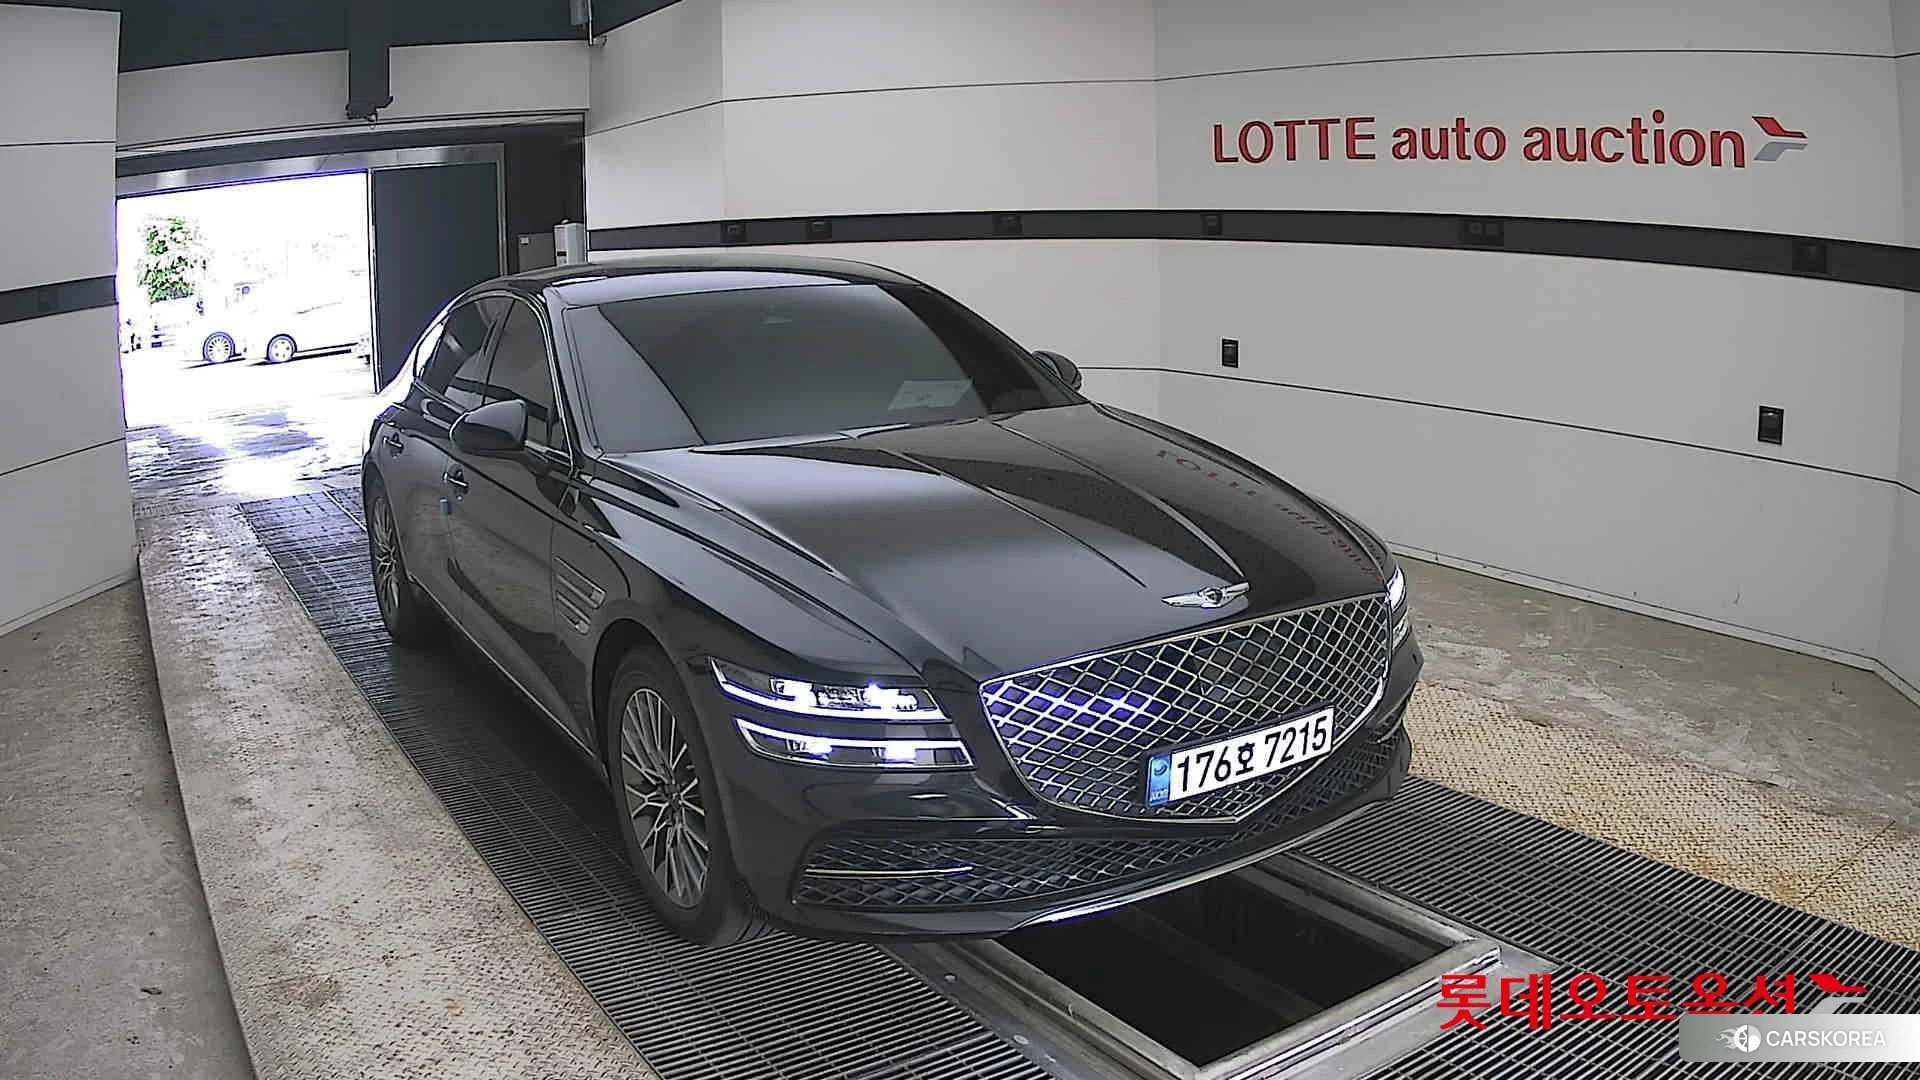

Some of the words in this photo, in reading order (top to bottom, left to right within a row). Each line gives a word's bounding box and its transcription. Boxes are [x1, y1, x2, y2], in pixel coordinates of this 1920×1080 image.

[1213, 117, 1377, 164] LOTTE
[1391, 117, 1507, 163] auto
[1522, 109, 1746, 168] auction
[1177, 743, 1256, 792] 176호
[1265, 716, 1328, 768] 7215
